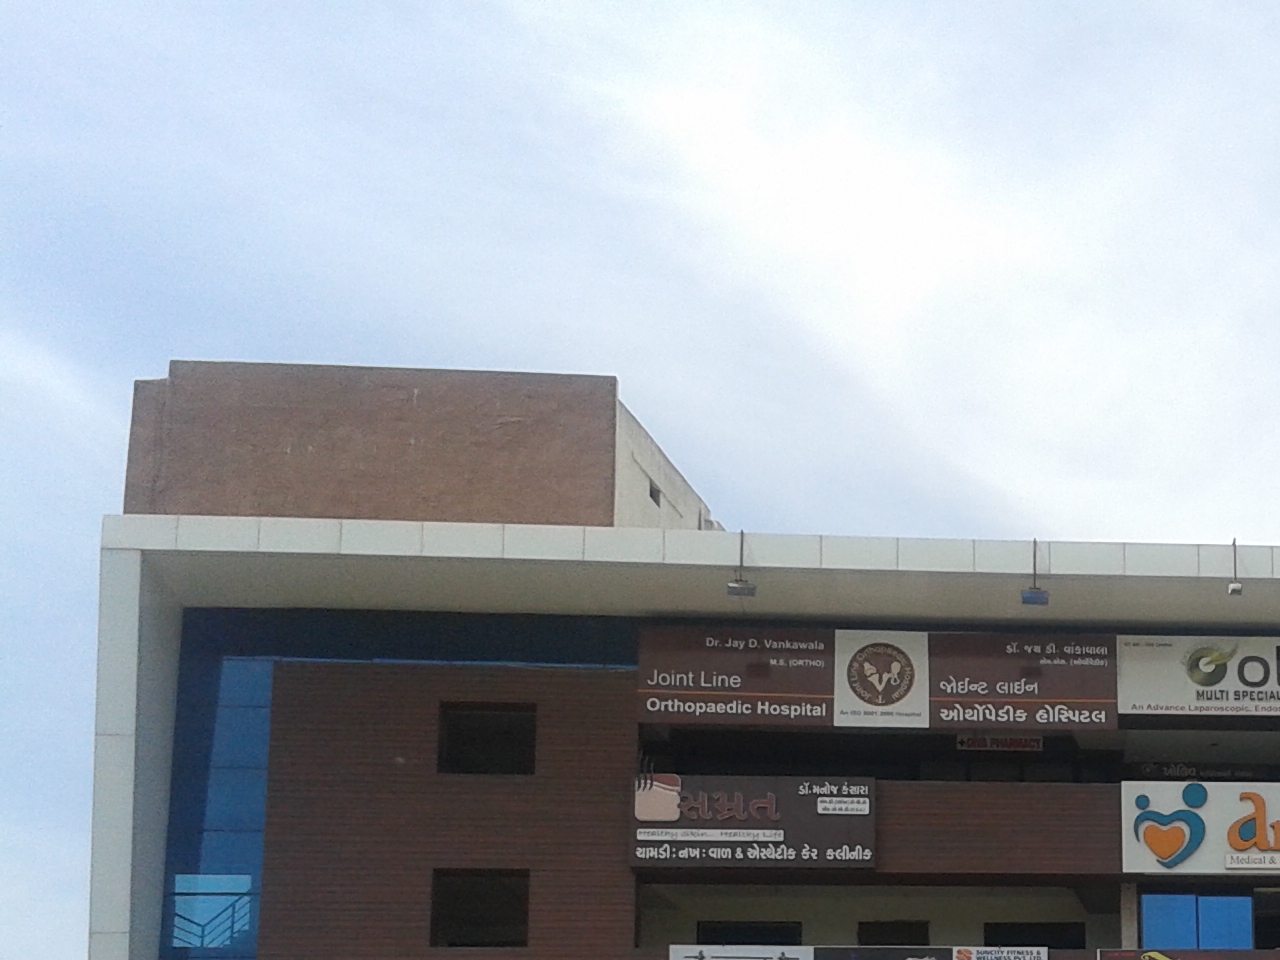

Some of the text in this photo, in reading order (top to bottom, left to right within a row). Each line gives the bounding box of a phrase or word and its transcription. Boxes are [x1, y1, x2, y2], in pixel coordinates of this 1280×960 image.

[706, 637, 824, 650] Dr. Jay D. Vankawala
[647, 670, 741, 688] Joint Line
[940, 676, 1039, 695] જોઈન્ટ લાઈન
[1196, 690, 1229, 701] MULTI
[647, 697, 826, 718] Orthopaedic Hospital
[1035, 704, 1106, 723] હોસ્પિટલ
[734, 848, 744, 859] &
[1230, 855, 1265, 866] Medical
[1268, 855, 1277, 866] &
